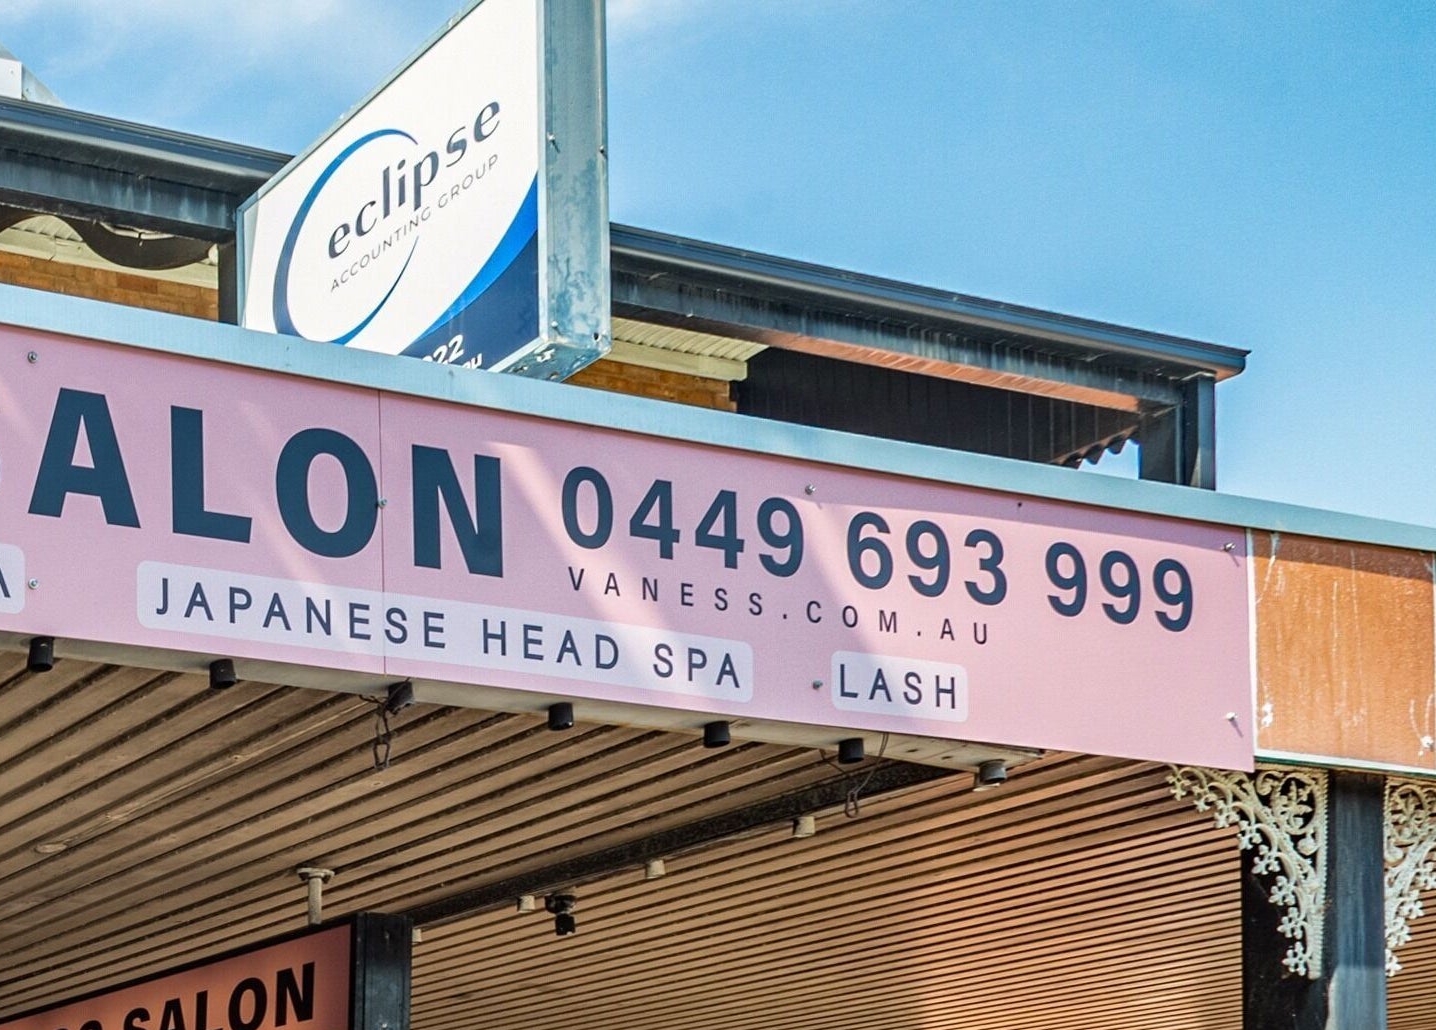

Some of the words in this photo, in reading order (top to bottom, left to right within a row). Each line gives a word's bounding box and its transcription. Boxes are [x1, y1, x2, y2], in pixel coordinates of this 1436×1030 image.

[327, 101, 500, 259] eclipse
[330, 206, 432, 292] ACCOUNTING
[437, 154, 499, 209] GROUP
[562, 466, 803, 577] 0449
[848, 512, 1006, 605] 693
[1046, 542, 1193, 632] 999
[156, 578, 446, 648] JAPANESE
[483, 619, 618, 669] HEAD
[654, 644, 739, 688] SPA
[840, 664, 955, 708] LASH
